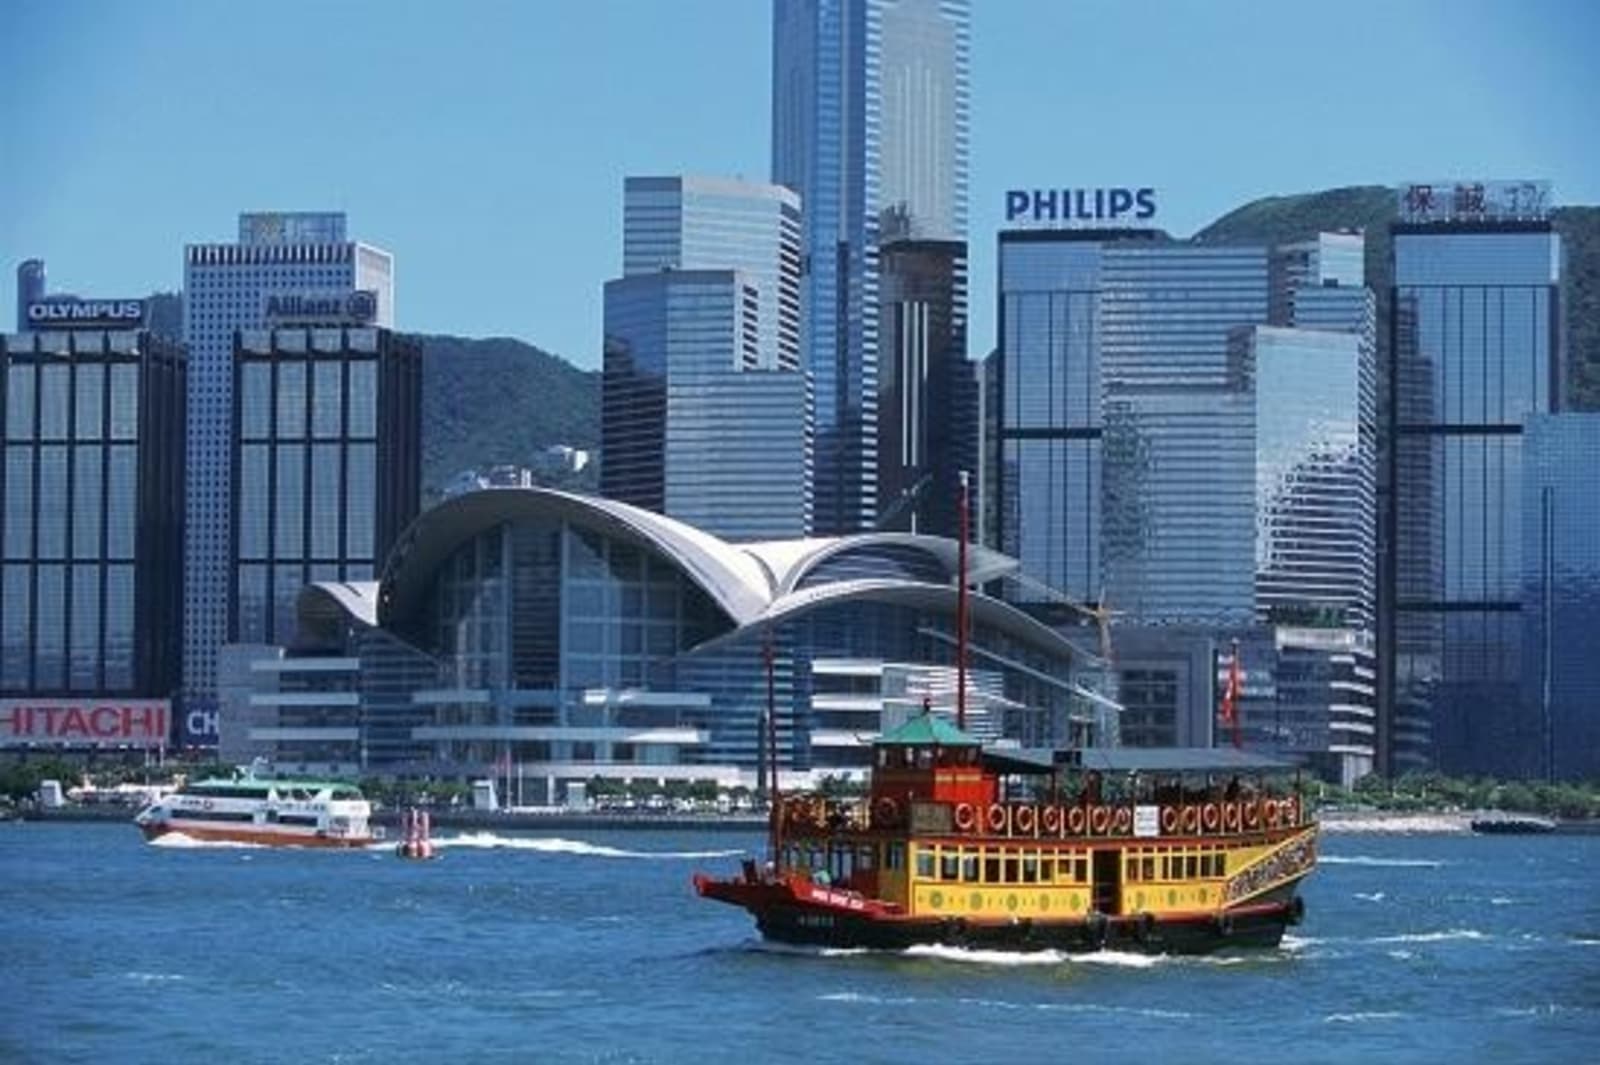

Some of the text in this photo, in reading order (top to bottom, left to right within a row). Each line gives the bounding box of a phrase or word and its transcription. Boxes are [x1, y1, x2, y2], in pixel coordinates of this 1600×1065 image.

[1006, 188, 1155, 221] PHILIPS
[28, 301, 141, 319] OLYMPUS
[266, 295, 341, 316] Allianz
[187, 710, 219, 735] CH
